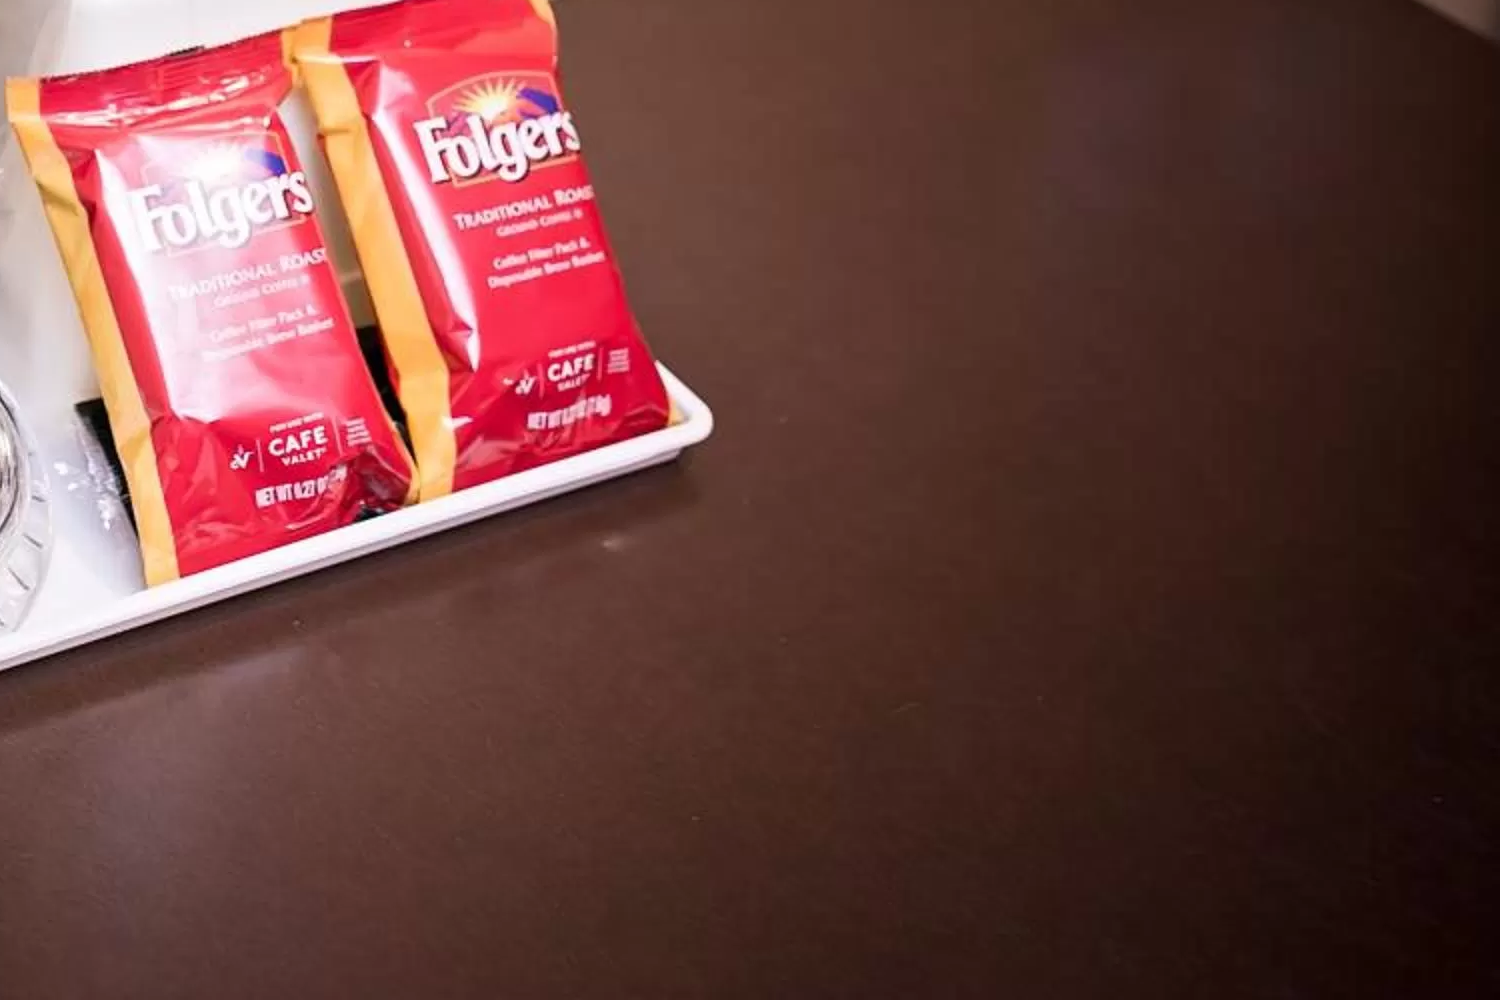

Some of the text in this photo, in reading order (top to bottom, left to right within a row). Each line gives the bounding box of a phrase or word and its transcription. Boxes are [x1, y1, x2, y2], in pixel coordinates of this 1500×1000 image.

[413, 111, 581, 183] Folgers
[128, 171, 313, 250] Folgers
[453, 195, 553, 229] TRADITIONAL
[168, 263, 277, 300] TRADITIONAL
[547, 353, 595, 382] CAFE
[268, 426, 328, 456] CAFE
[281, 448, 326, 466] VALET
[255, 486, 276, 509] NET
[276, 483, 293, 503] WT
